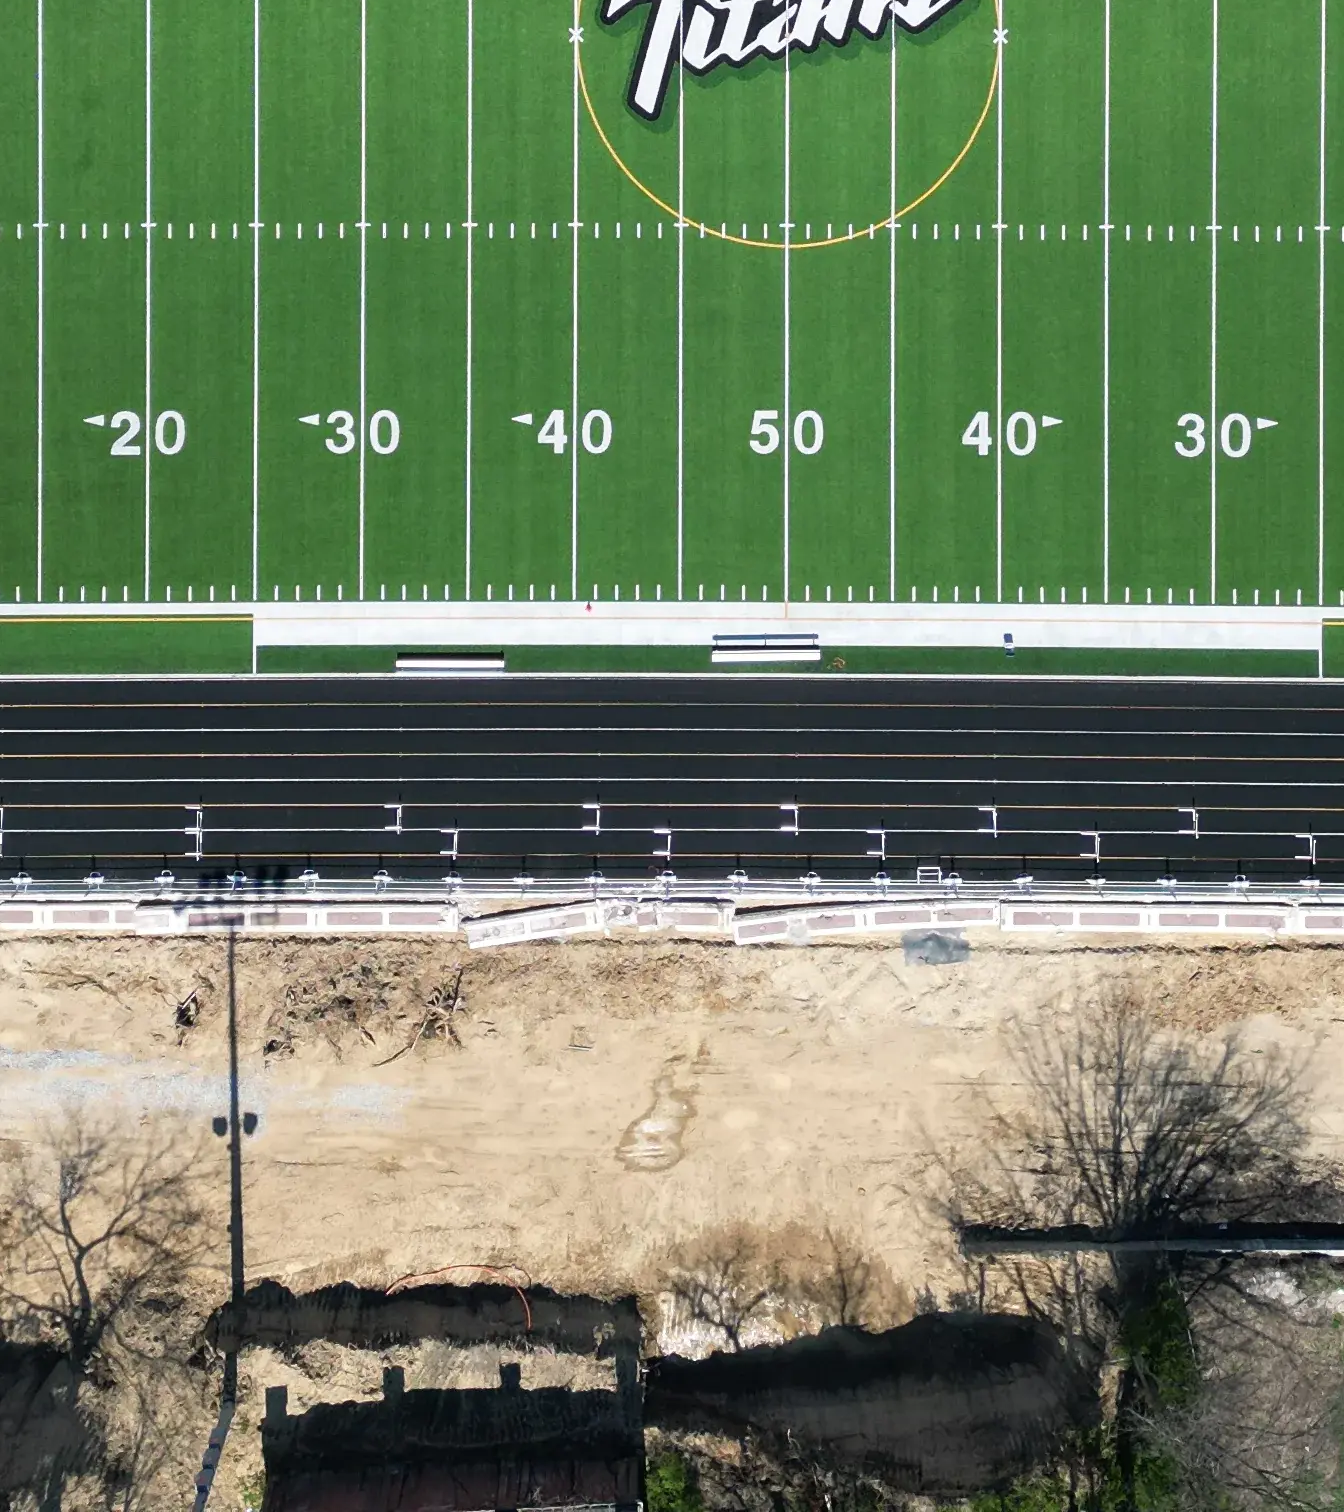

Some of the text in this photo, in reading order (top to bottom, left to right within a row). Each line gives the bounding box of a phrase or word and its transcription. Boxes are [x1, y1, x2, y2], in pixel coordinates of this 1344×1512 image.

[110, 410, 186, 456] 20
[325, 409, 400, 455] 30
[537, 409, 613, 454] 40
[749, 409, 824, 455] 50
[961, 411, 1037, 456] 40
[1174, 412, 1252, 458] 30
